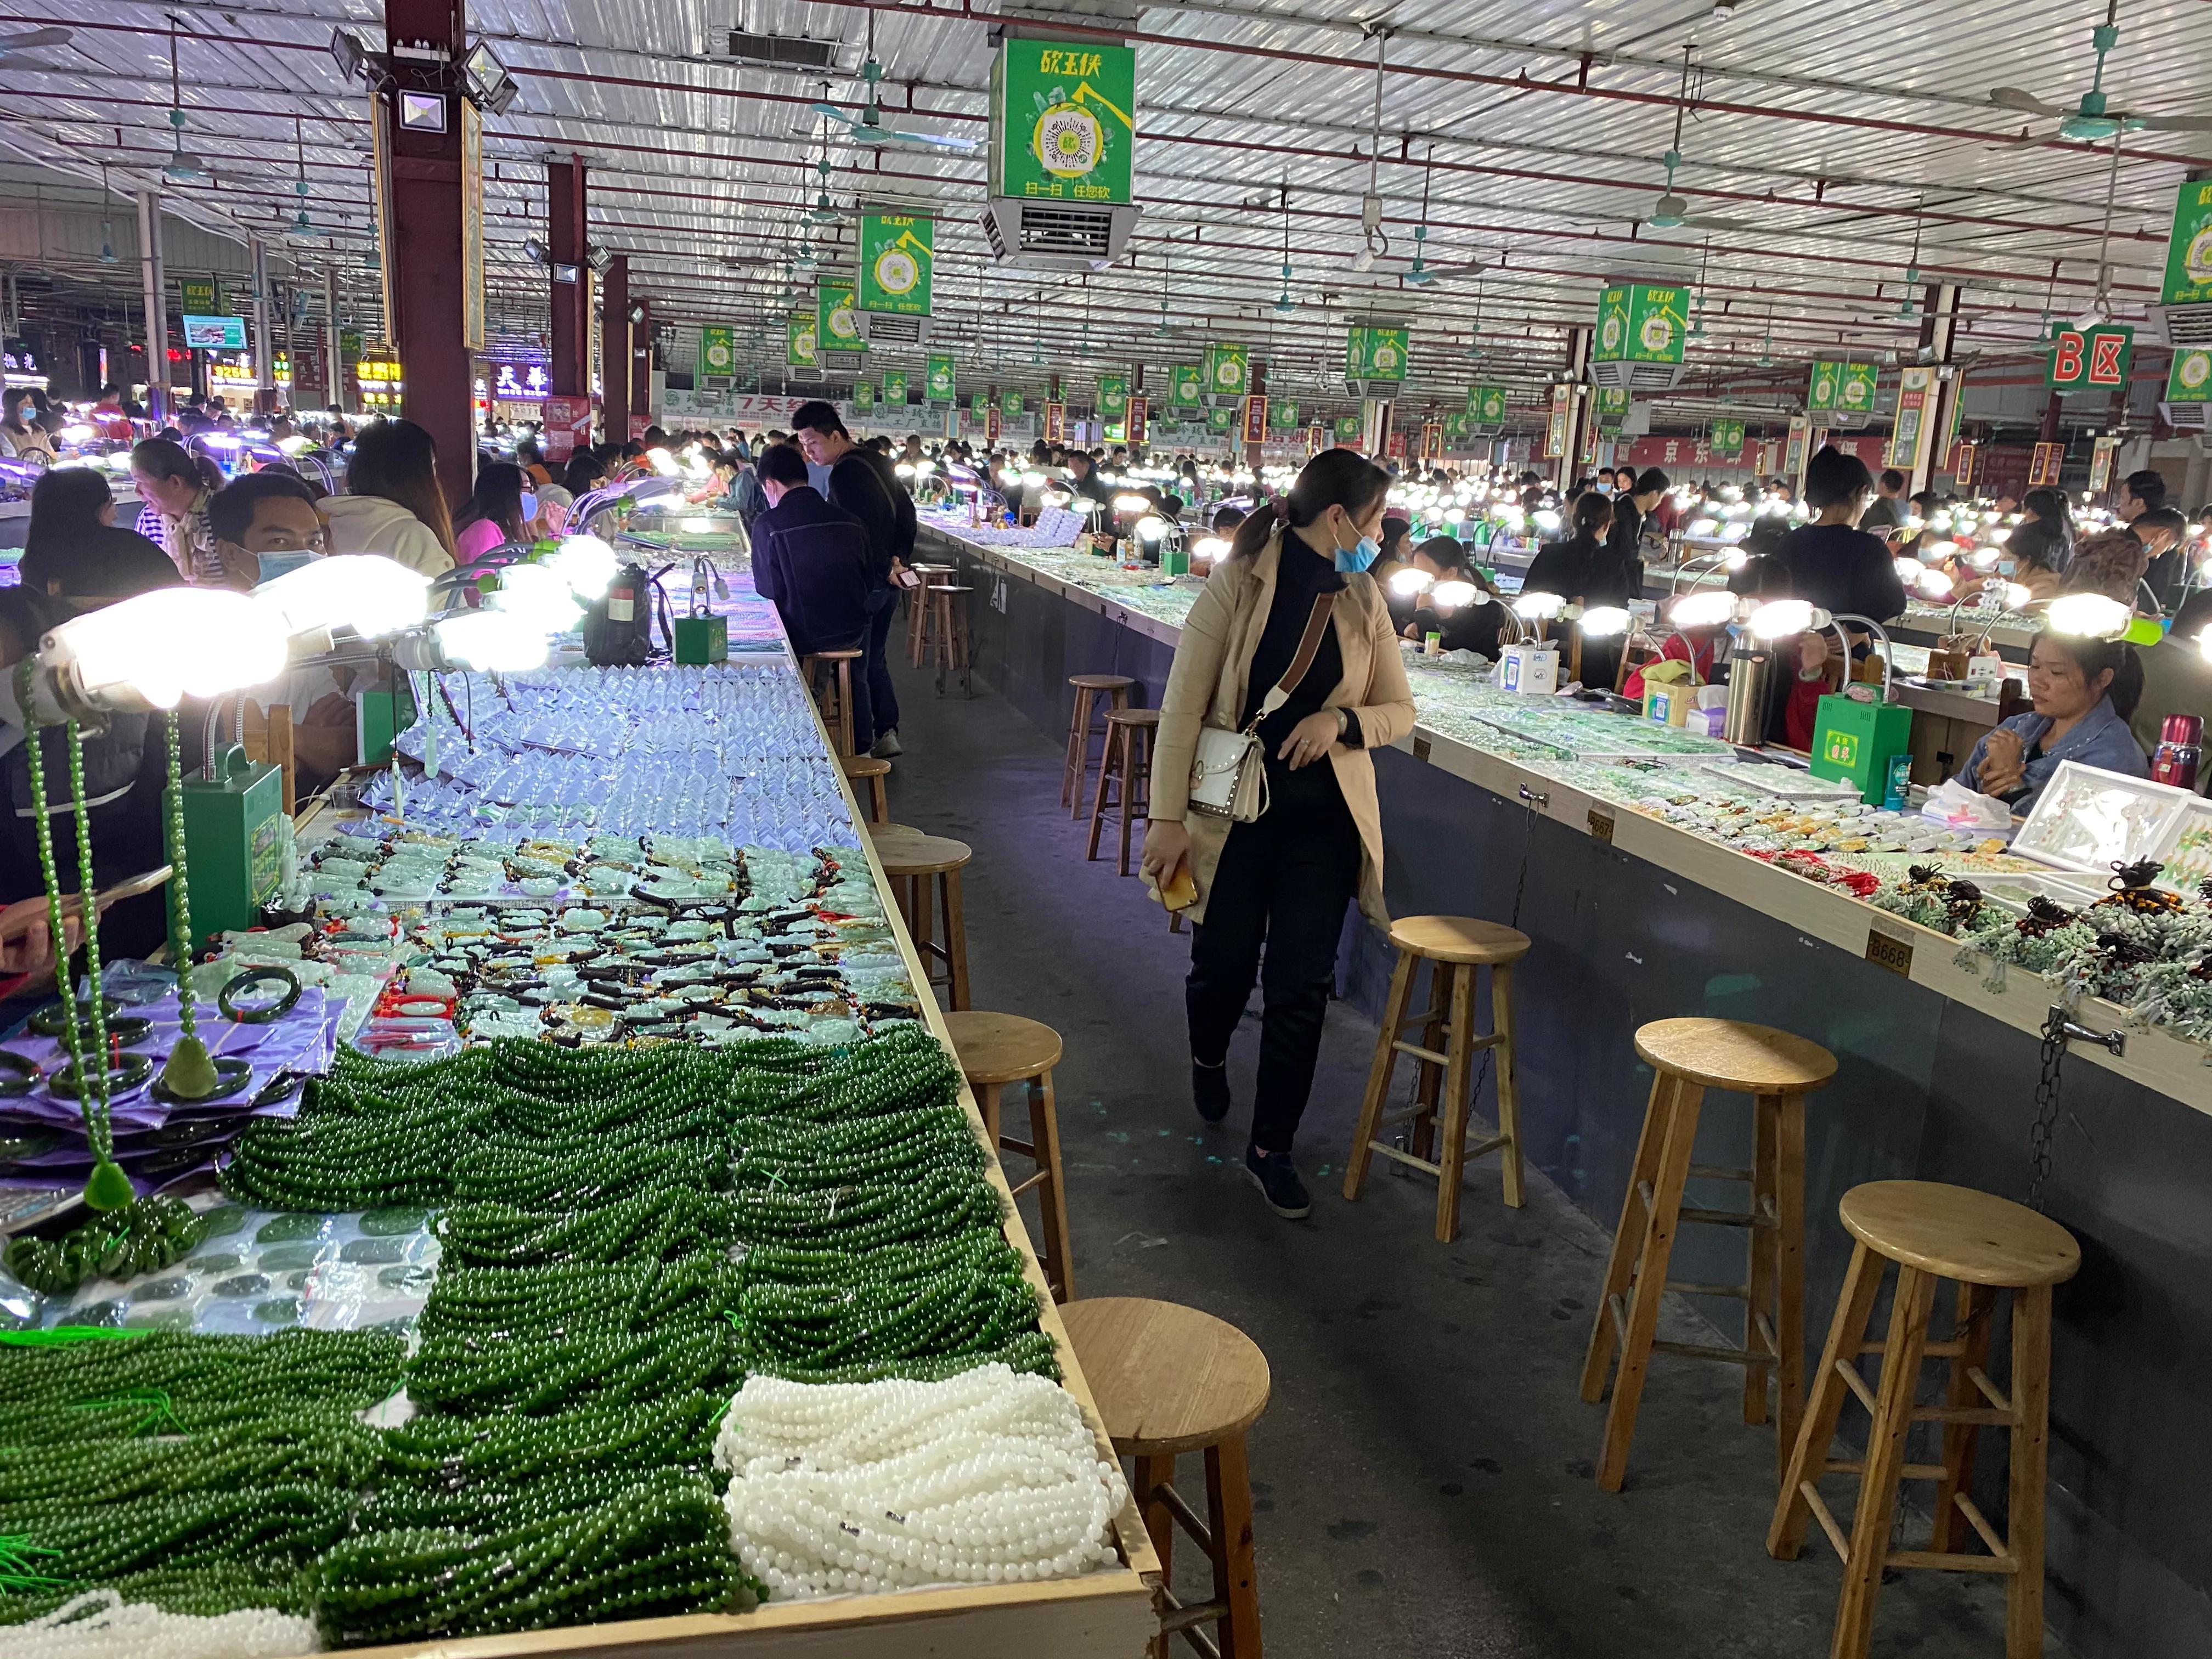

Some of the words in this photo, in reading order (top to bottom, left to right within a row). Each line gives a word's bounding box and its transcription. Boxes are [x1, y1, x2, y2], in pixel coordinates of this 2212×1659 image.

[1040, 49, 1102, 78] 砍玉侠
[1025, 180, 1063, 197] 扫一扫
[1073, 184, 1111, 199] 任您砍
[868, 300, 893, 309] 扫一扫
[2053, 331, 2126, 385] B区
